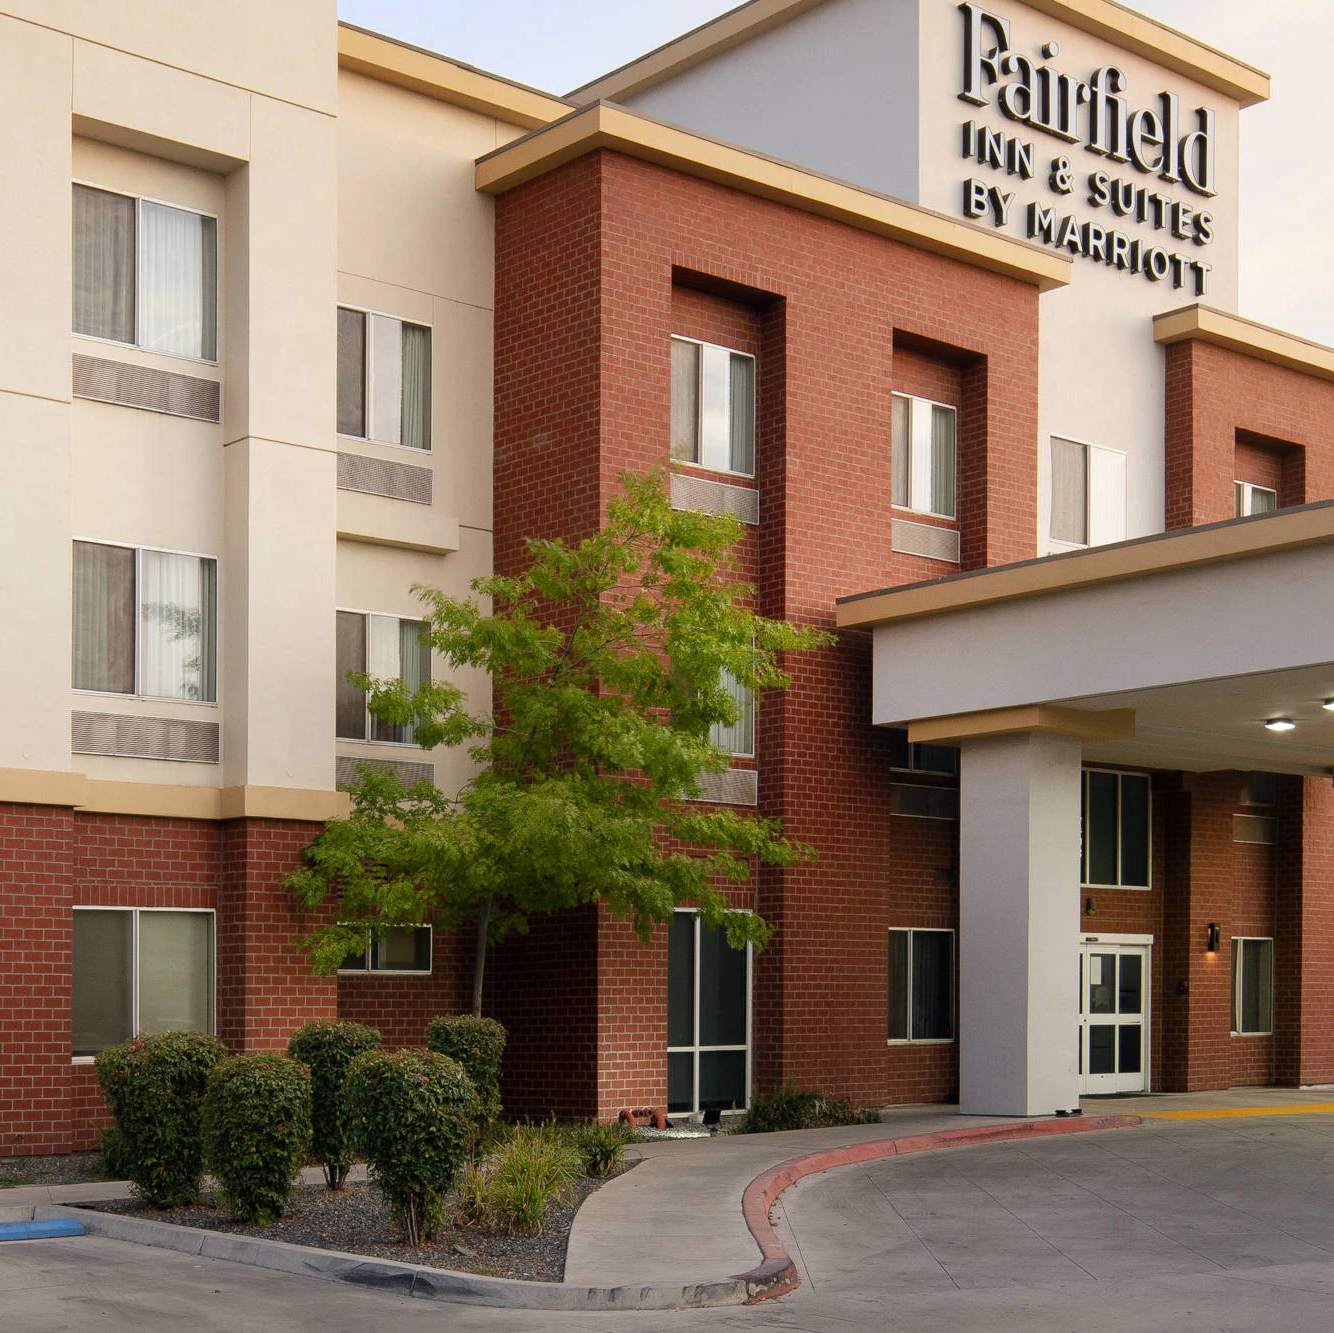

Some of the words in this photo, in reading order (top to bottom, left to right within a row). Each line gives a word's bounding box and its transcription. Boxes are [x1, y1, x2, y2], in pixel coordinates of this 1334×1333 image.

[957, 2, 1217, 197] Fairfield
[963, 119, 1034, 179] INN
[1049, 155, 1073, 194] &
[1087, 170, 1214, 246] SUITES
[963, 177, 1015, 227] BY
[1027, 201, 1212, 296] MARRIOTT
